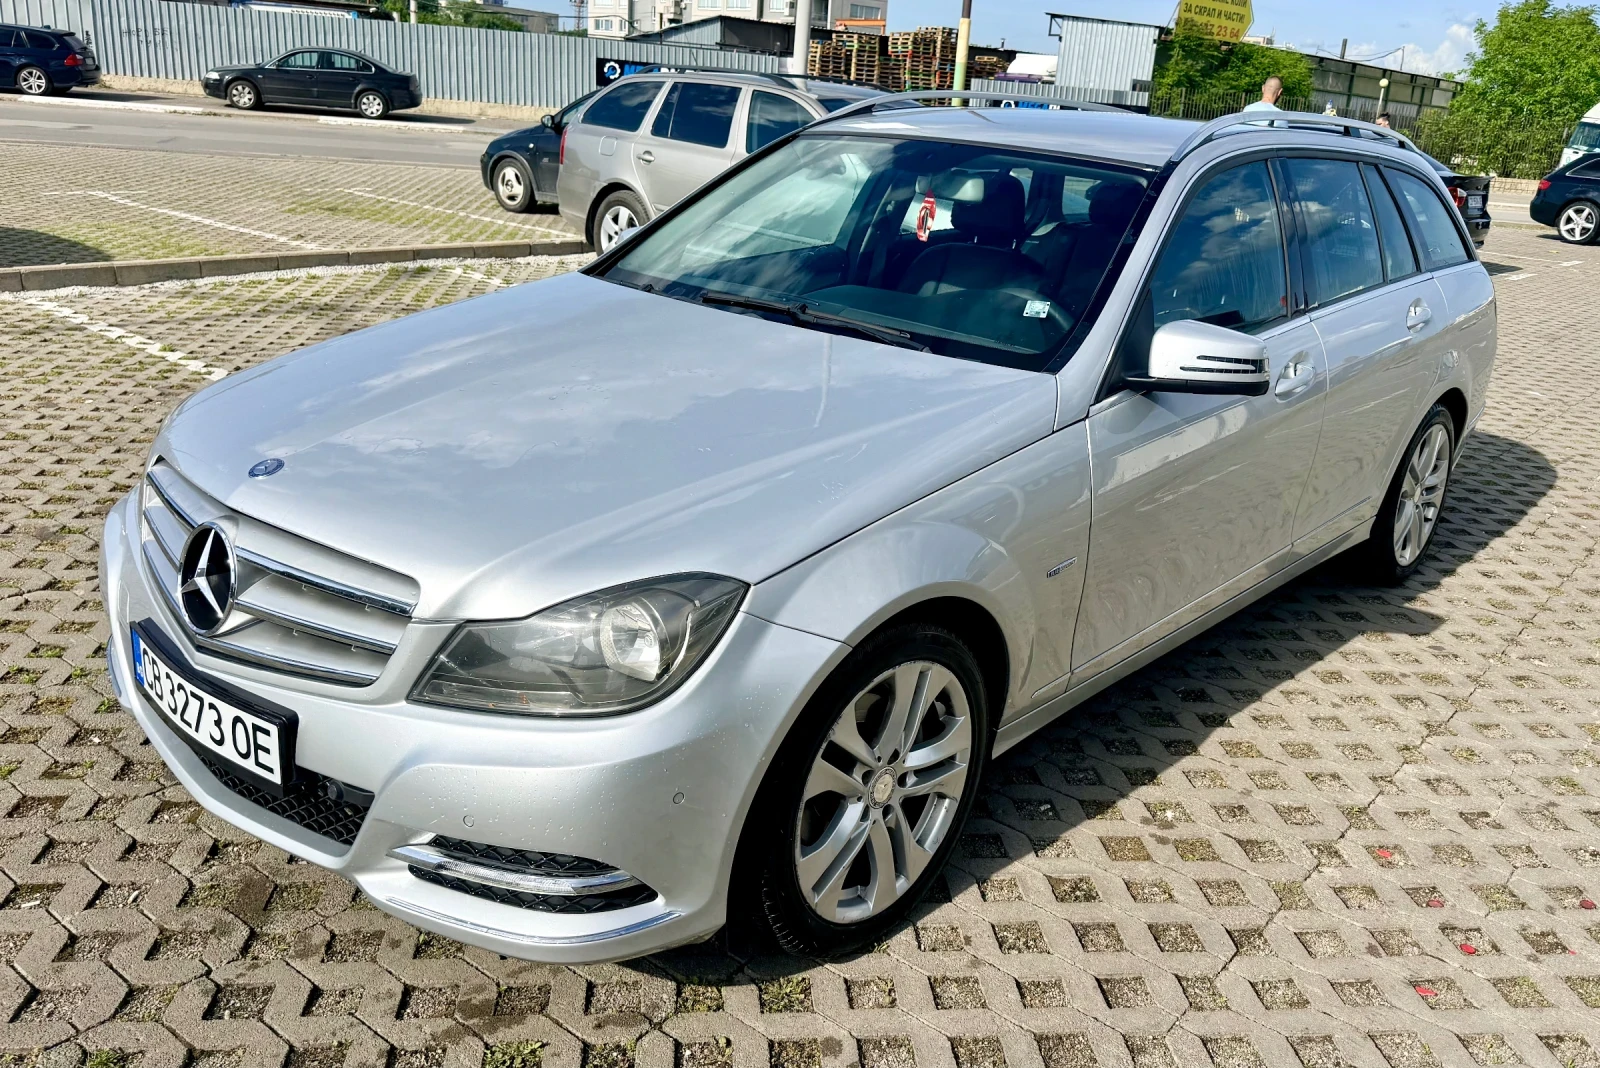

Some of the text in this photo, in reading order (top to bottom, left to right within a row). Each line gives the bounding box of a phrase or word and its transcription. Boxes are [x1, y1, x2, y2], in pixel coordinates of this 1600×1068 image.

[1184, 3, 1192, 14] ЗА
[1194, 5, 1216, 18] СКРАП
[1217, 10, 1223, 19] И
[1216, 25, 1228, 37] 23
[1230, 28, 1240, 39] 64
